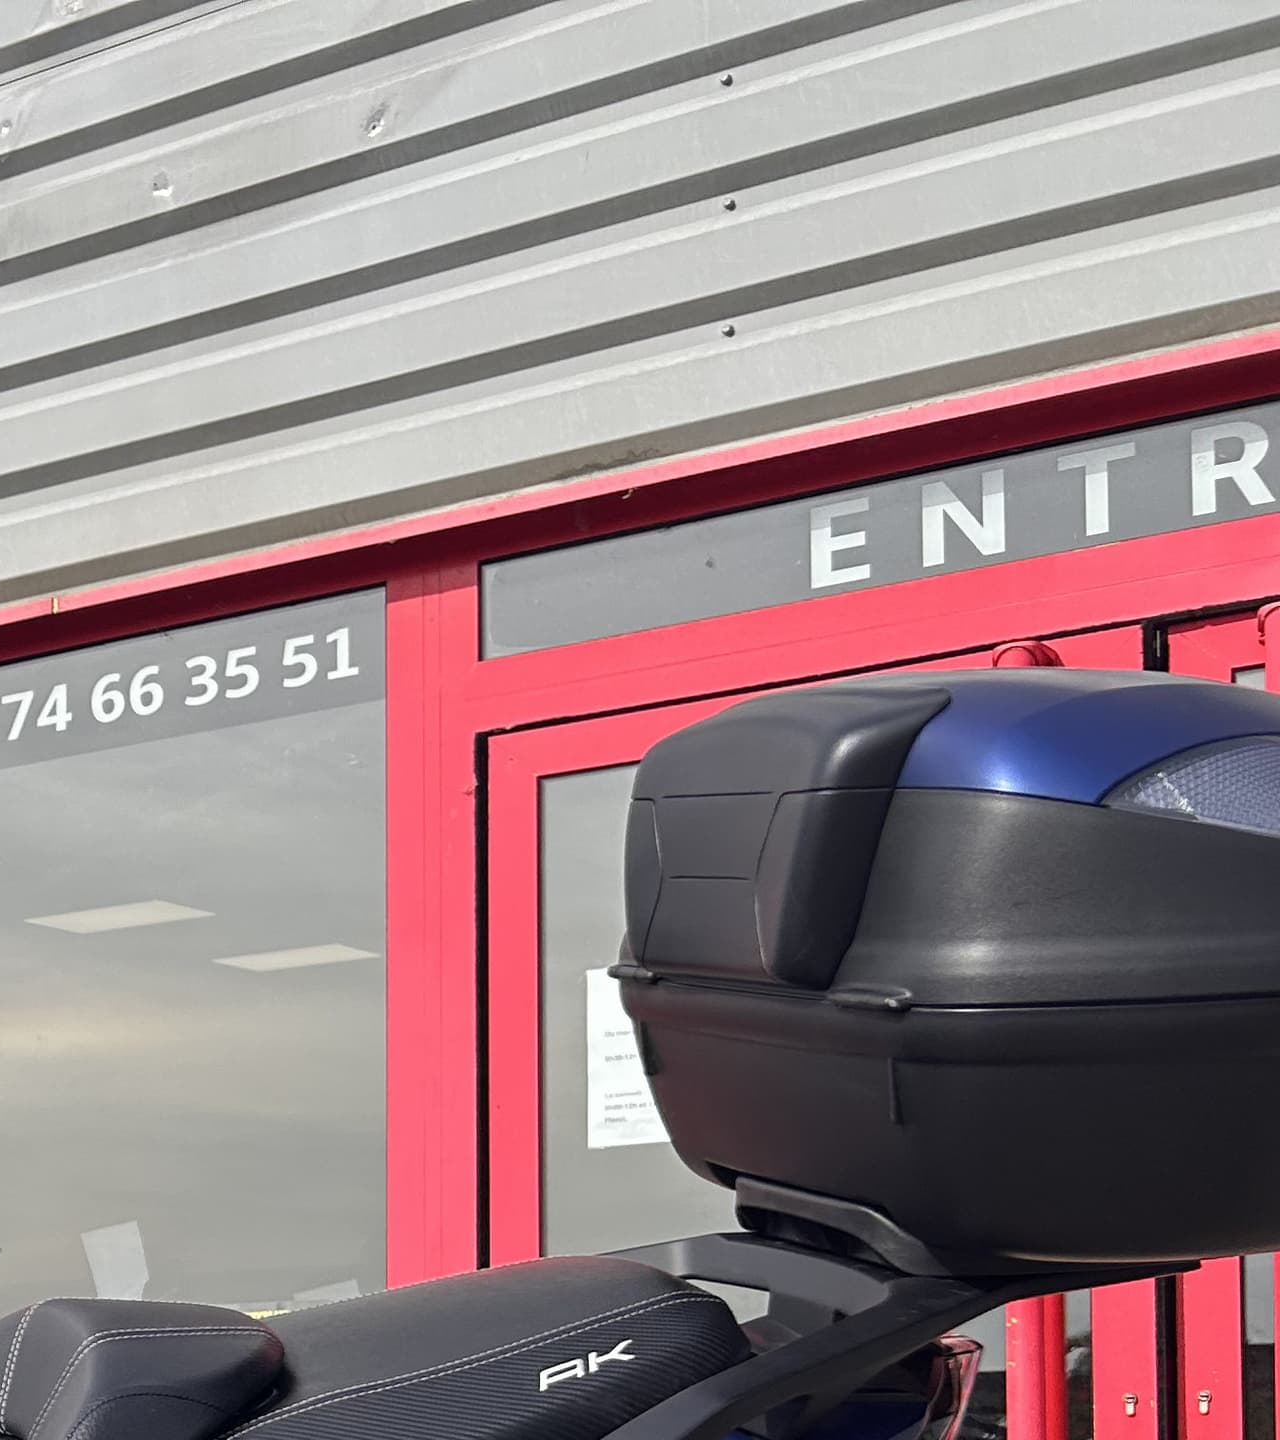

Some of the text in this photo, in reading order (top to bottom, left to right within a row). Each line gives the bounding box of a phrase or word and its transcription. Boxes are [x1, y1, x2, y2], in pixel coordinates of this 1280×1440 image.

[810, 420, 1277, 589] ENTR
[1, 683, 72, 741] 74
[90, 665, 165, 723] 66
[184, 646, 260, 706] 35
[281, 627, 359, 688] 51
[539, 1339, 636, 1392] AK
